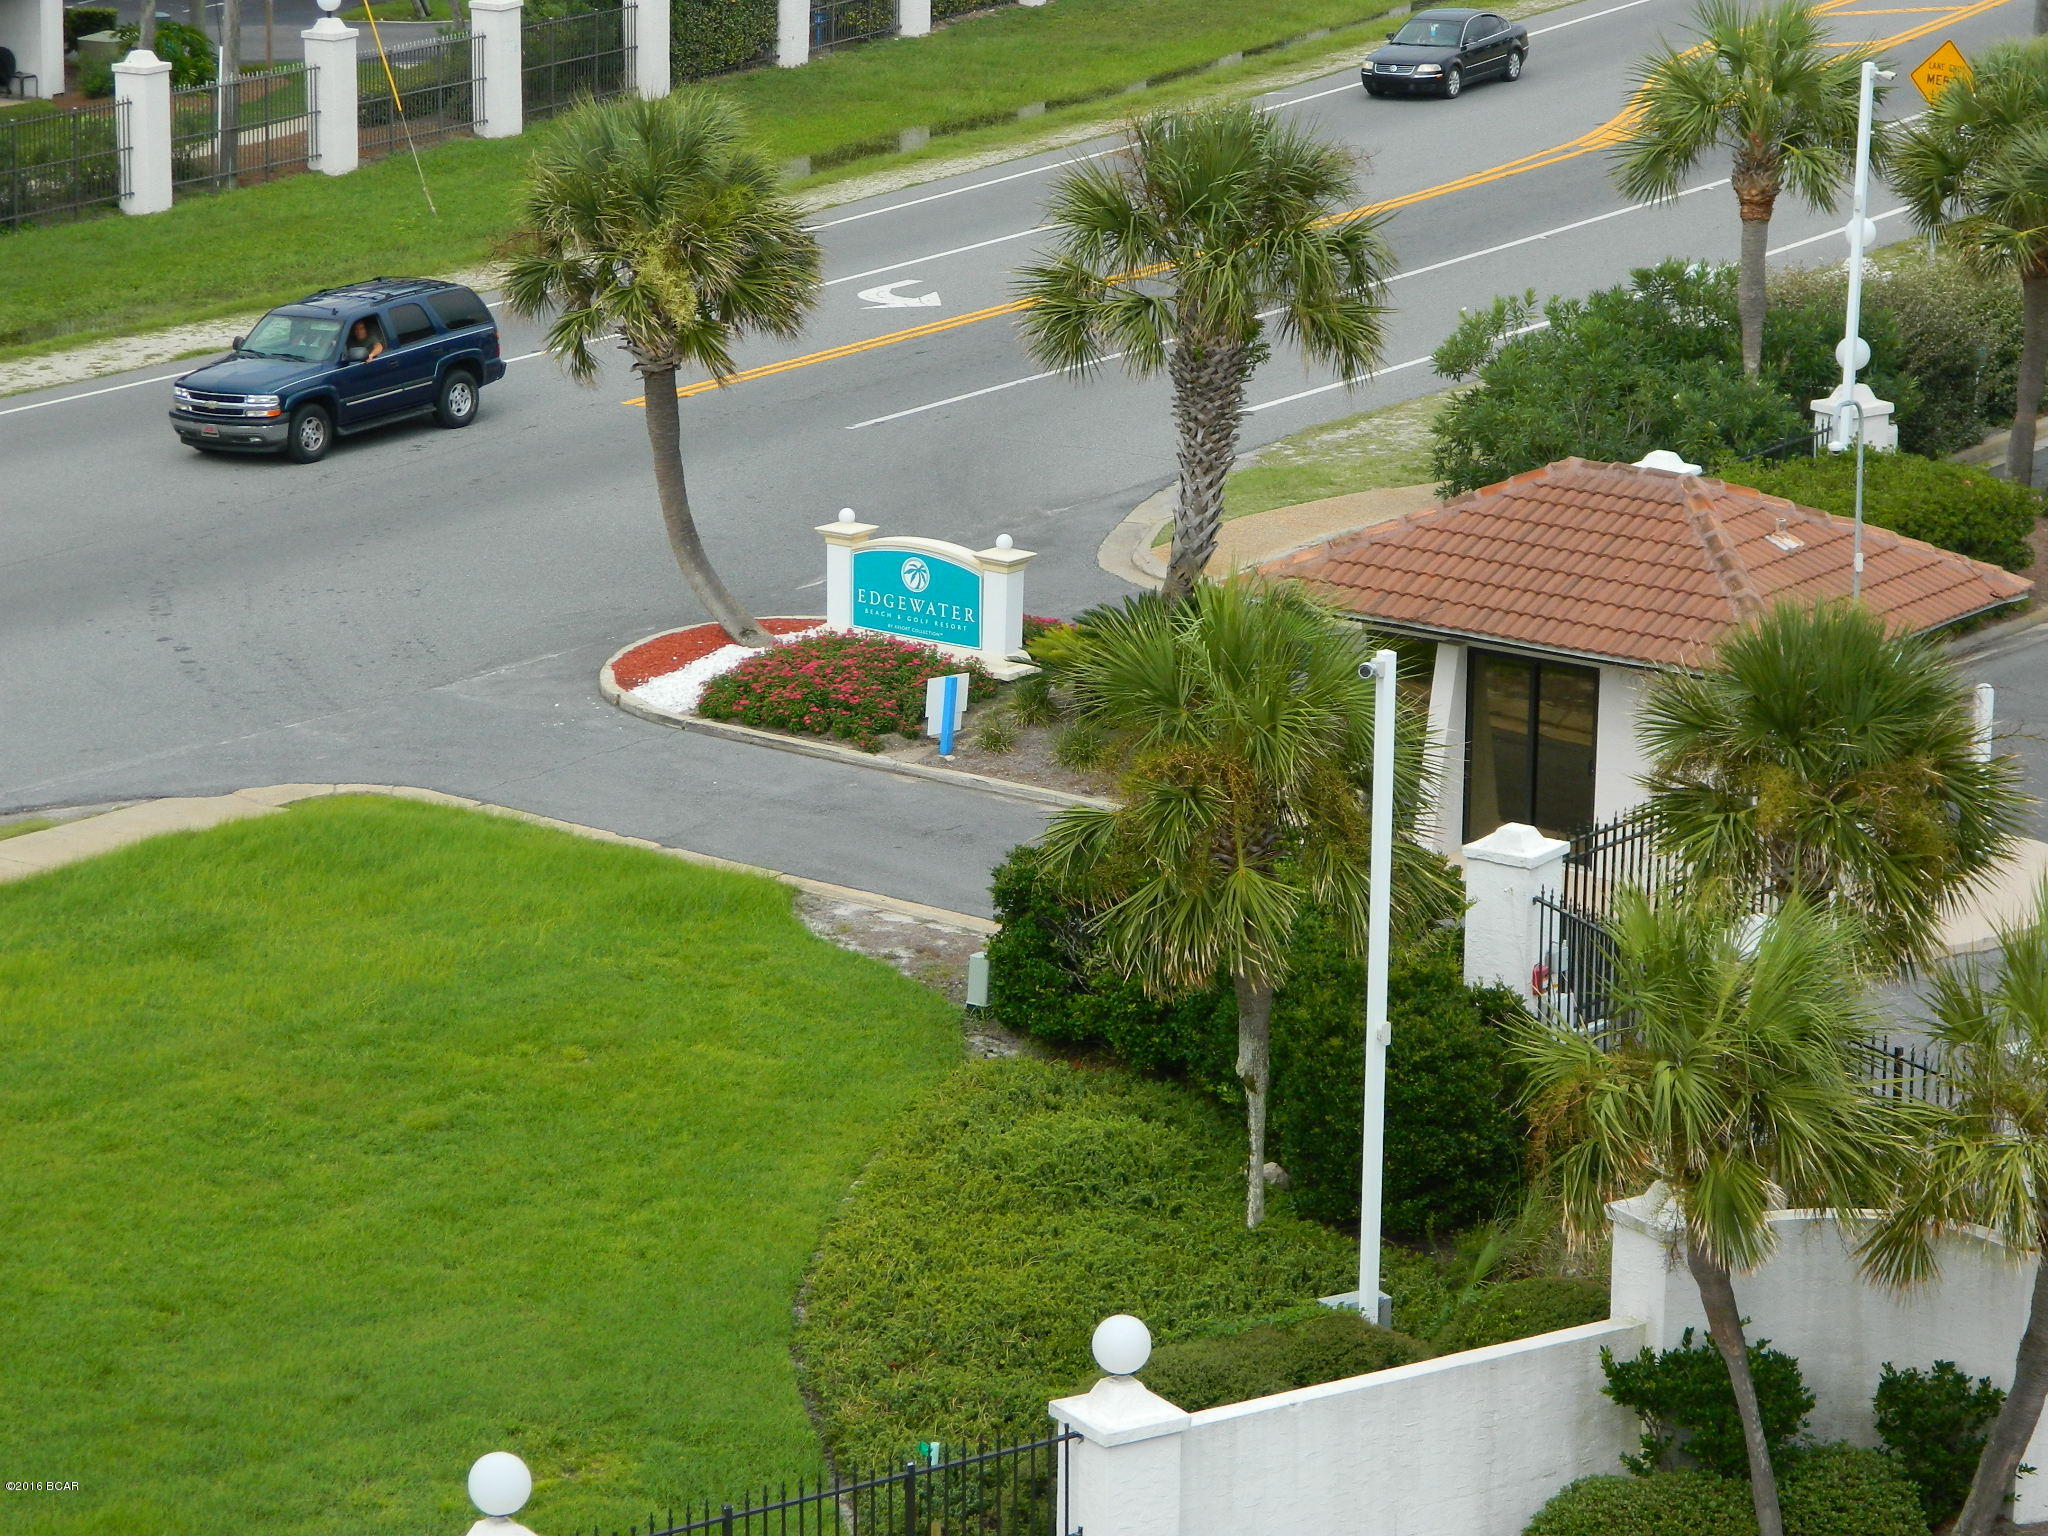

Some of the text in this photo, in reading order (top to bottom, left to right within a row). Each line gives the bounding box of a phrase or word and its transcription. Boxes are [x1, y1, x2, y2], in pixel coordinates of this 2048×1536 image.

[1928, 62, 1946, 71] LANE
[857, 588, 976, 623] EDGEWATER
[864, 607, 892, 618] BEACH
[906, 615, 929, 625] GOLF
[934, 620, 968, 631] RESORT
